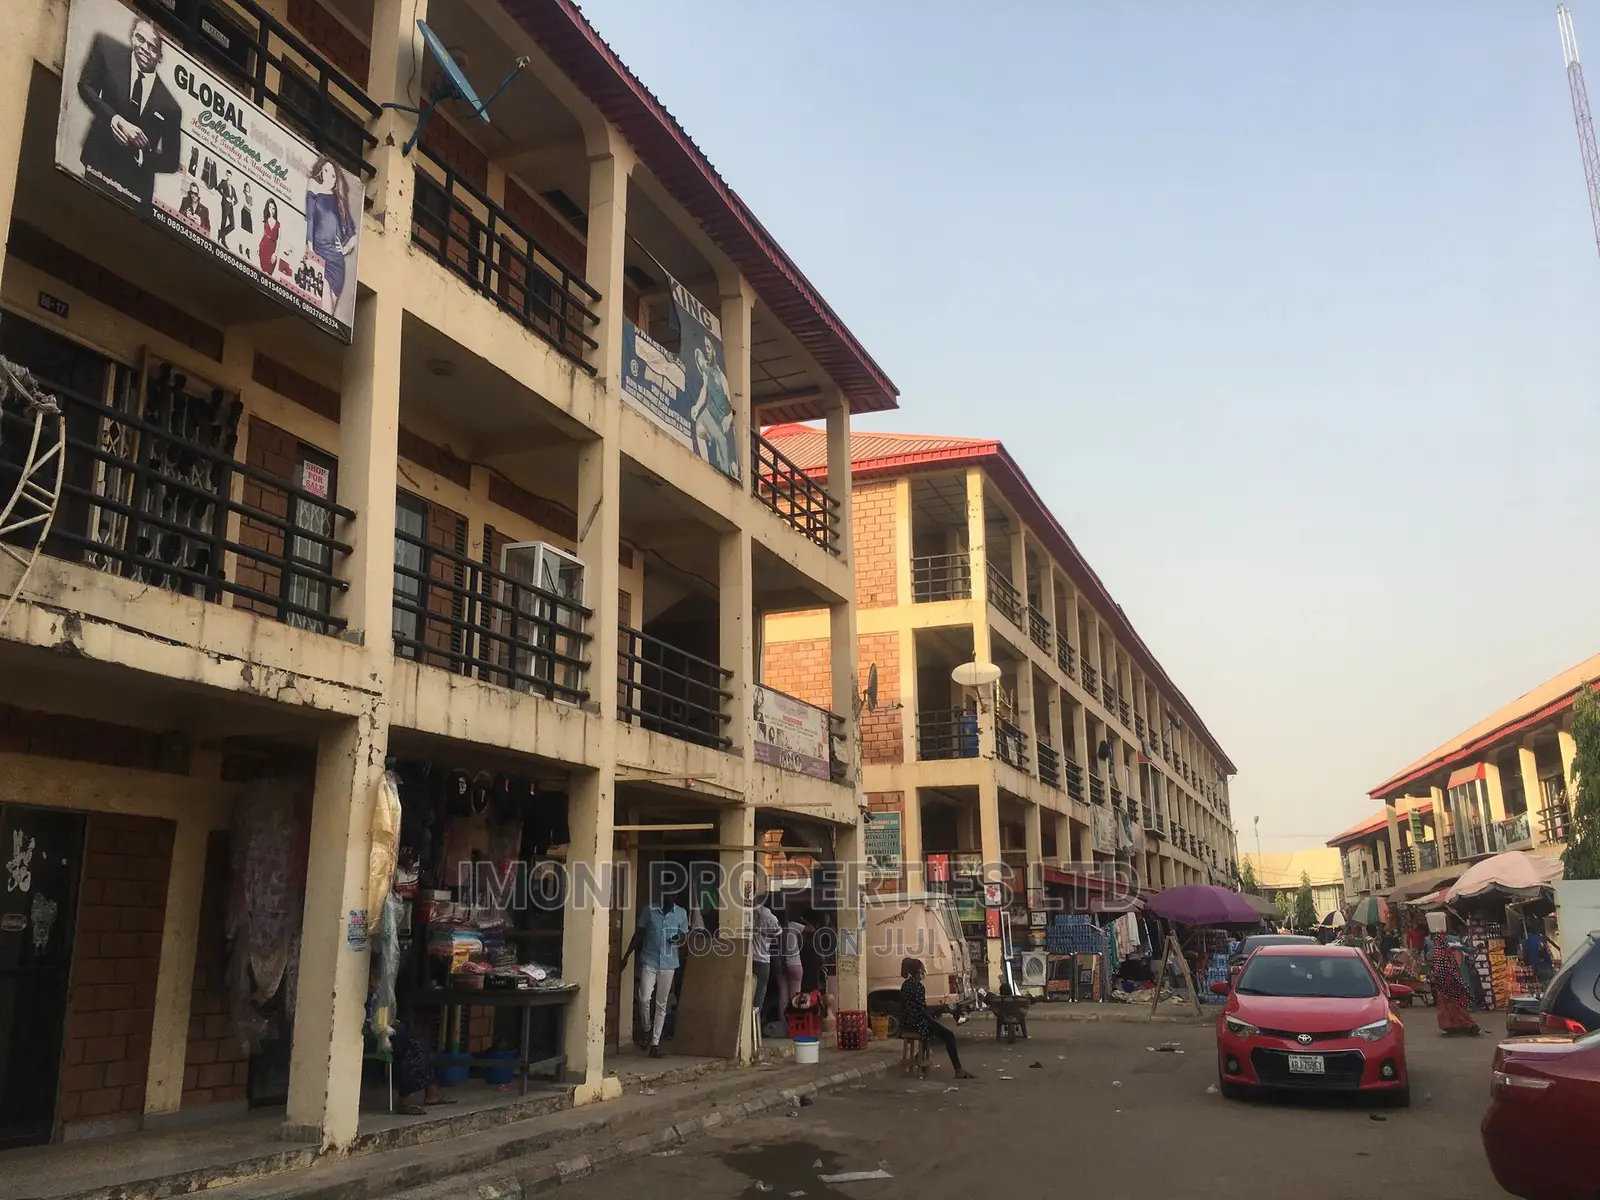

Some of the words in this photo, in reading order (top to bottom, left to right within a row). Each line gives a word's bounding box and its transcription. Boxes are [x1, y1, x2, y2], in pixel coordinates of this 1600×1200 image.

[174, 64, 248, 136] GLOBAL
[197, 110, 262, 163] Collections
[263, 158, 289, 181] Ltd
[152, 208, 167, 223] Tel:
[305, 462, 327, 476] SHOP
[307, 471, 324, 485] FOR
[305, 479, 326, 493] SALE
